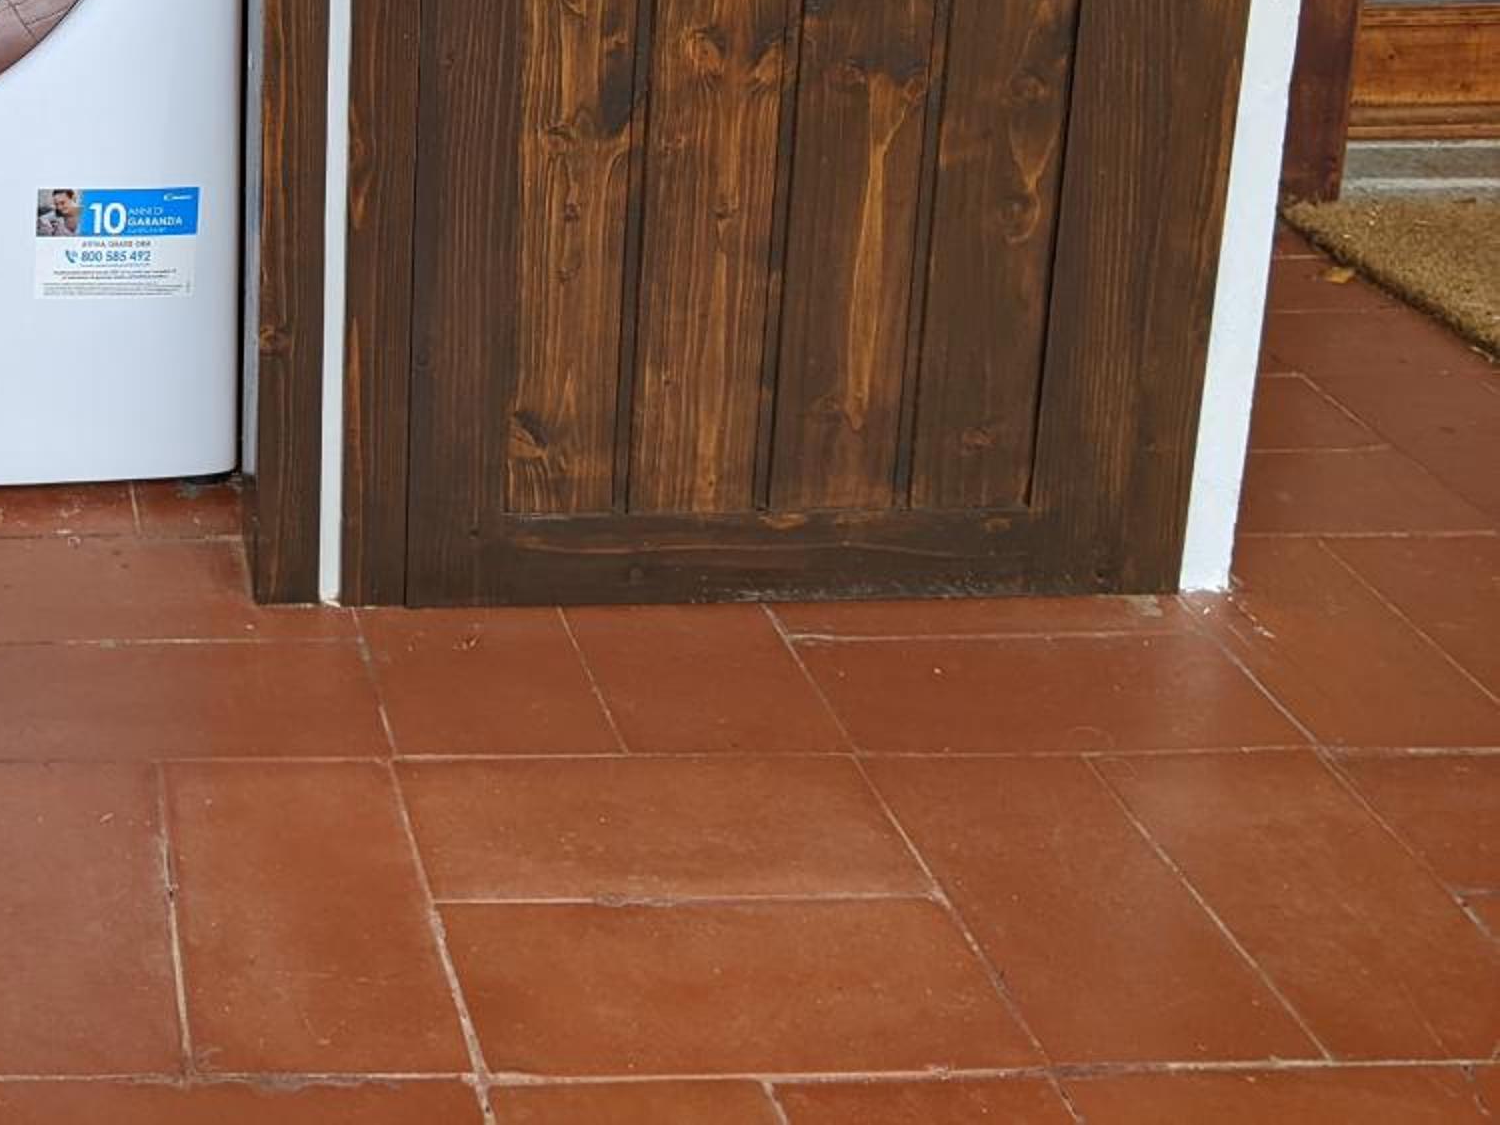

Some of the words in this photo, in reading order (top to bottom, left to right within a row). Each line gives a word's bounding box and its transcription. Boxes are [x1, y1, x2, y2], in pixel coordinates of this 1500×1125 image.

[89, 202, 127, 235] 10
[128, 216, 183, 227] GARANZIA
[81, 250, 103, 262] 800
[129, 250, 151, 262] 492
